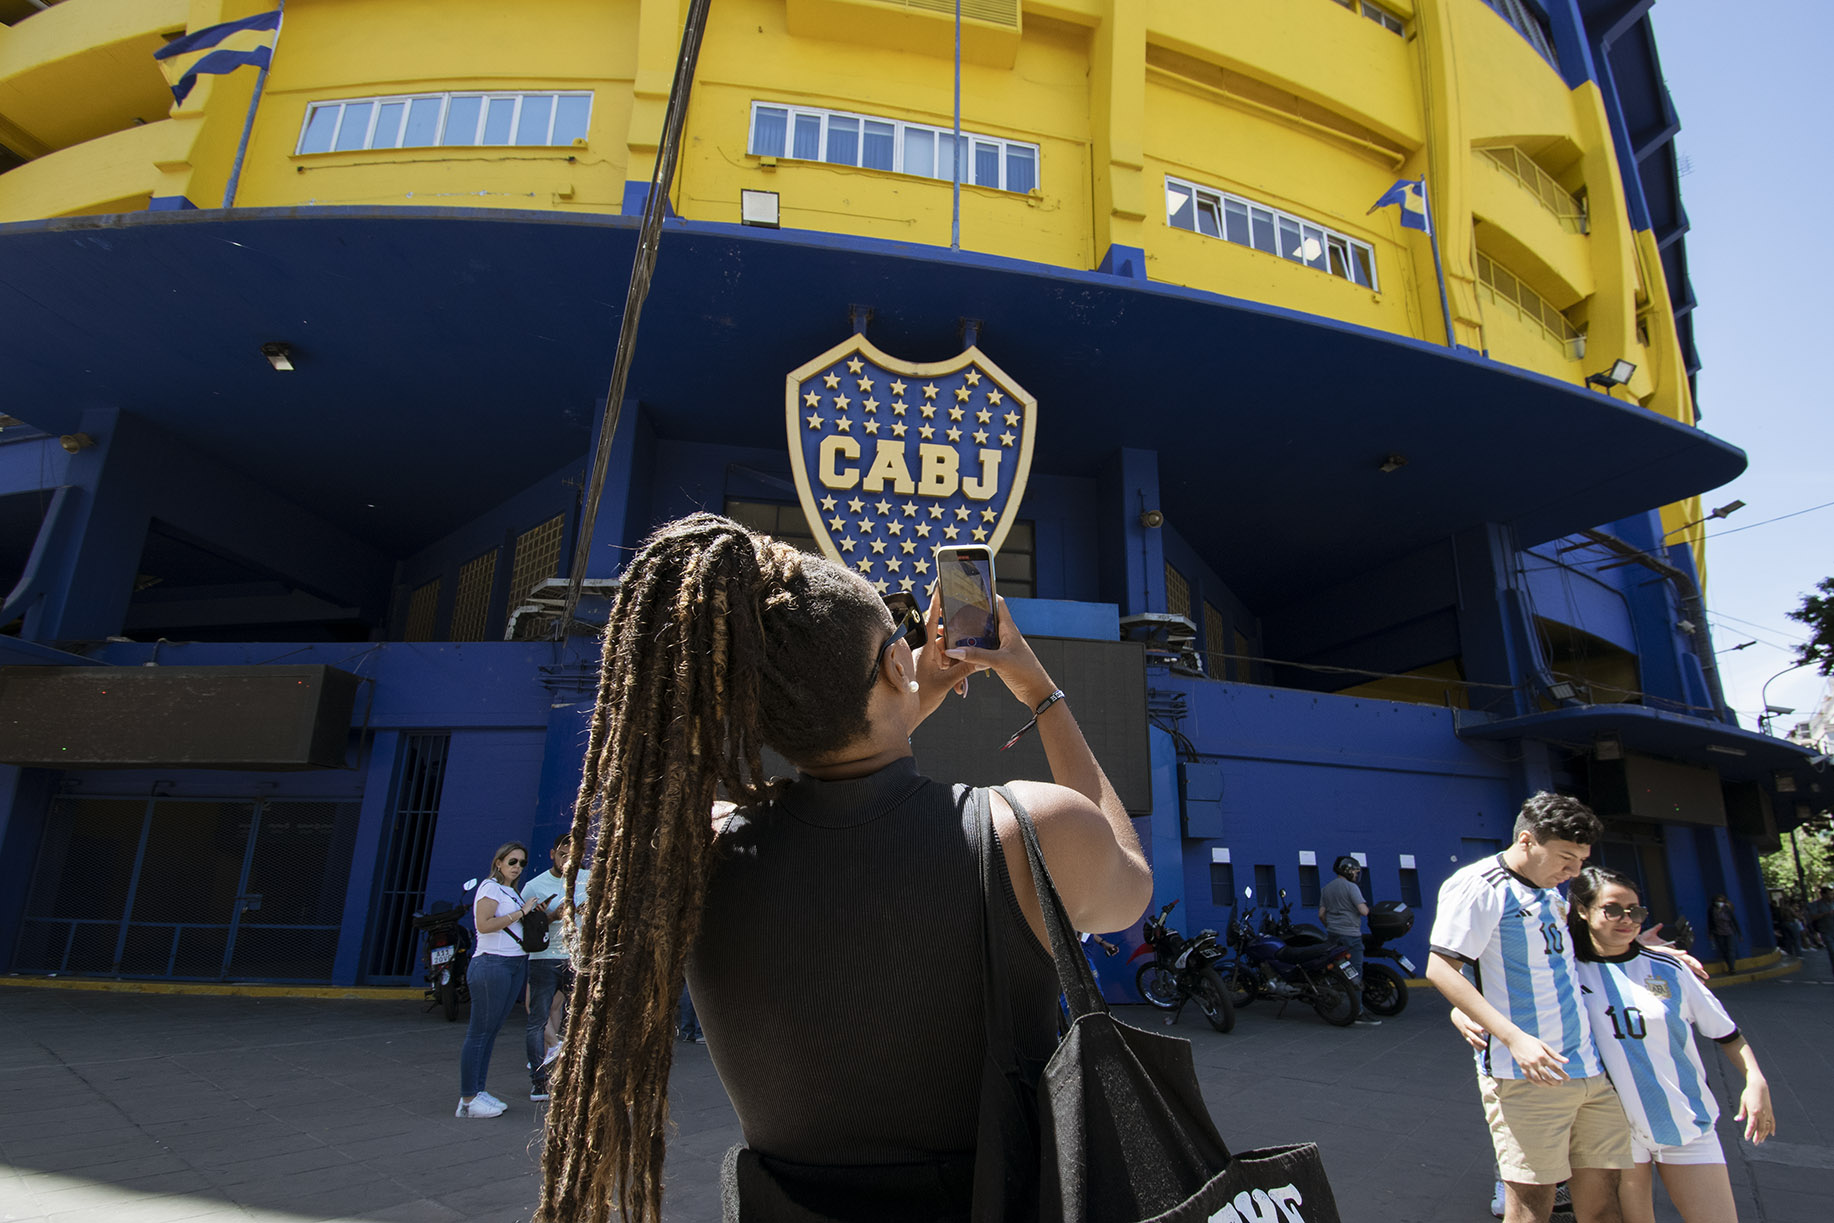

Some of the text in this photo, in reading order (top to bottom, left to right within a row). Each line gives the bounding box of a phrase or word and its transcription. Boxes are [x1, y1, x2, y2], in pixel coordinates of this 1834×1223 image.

[819, 434, 1002, 500] CABJ
[1539, 922, 1564, 954] 10
[1605, 1005, 1647, 1040] 10
